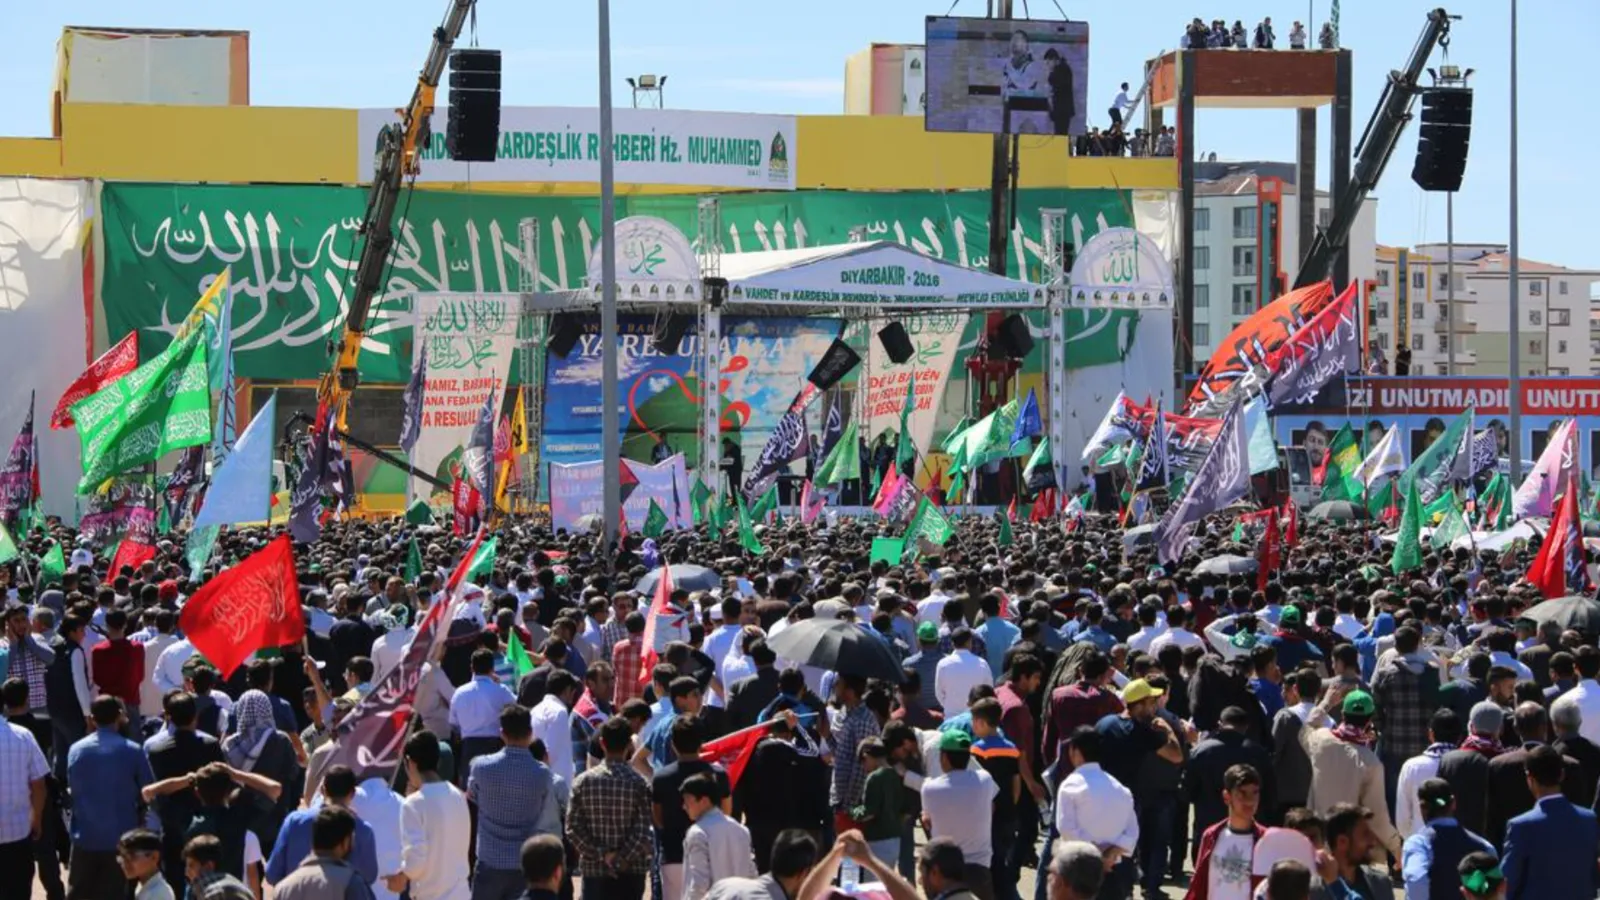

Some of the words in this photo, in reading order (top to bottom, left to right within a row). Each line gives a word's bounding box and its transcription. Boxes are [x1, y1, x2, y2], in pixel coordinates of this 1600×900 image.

[588, 127, 656, 161] RHBERİ
[660, 134, 682, 163] Hz.
[688, 136, 762, 166] MUHAMMED
[913, 270, 940, 287] 2016
[745, 287, 779, 300] VAHDET
[1345, 383, 1372, 408] İZİ
